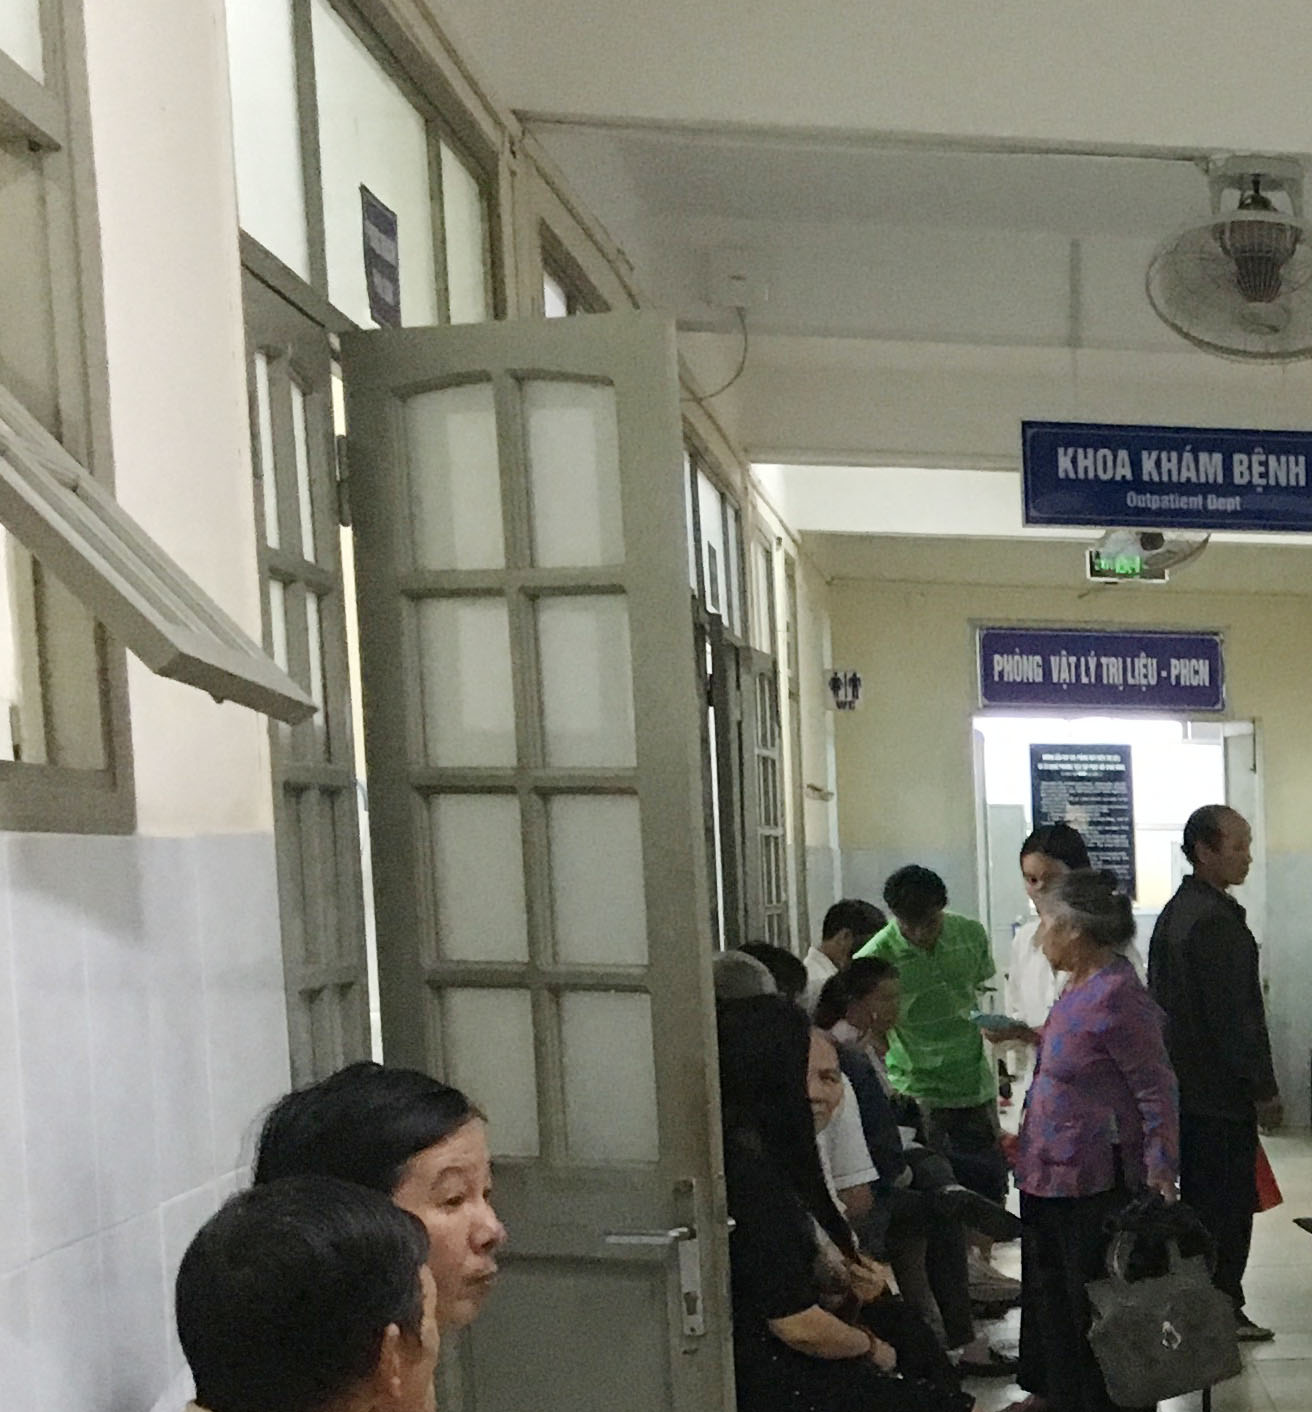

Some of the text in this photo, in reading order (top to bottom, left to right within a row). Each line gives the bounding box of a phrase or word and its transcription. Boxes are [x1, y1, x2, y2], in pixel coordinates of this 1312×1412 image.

[1057, 444, 1307, 493] KHOA KHÁM BỆNH
[1126, 490, 1203, 512] Outpatient
[993, 647, 1044, 684] PHÒNG
[1051, 649, 1077, 690] VẬT
[1080, 650, 1097, 685] LÝ
[1100, 656, 1123, 691] TRỊ
[1127, 651, 1158, 692] LIỆU
[1170, 658, 1210, 687] PHCN
